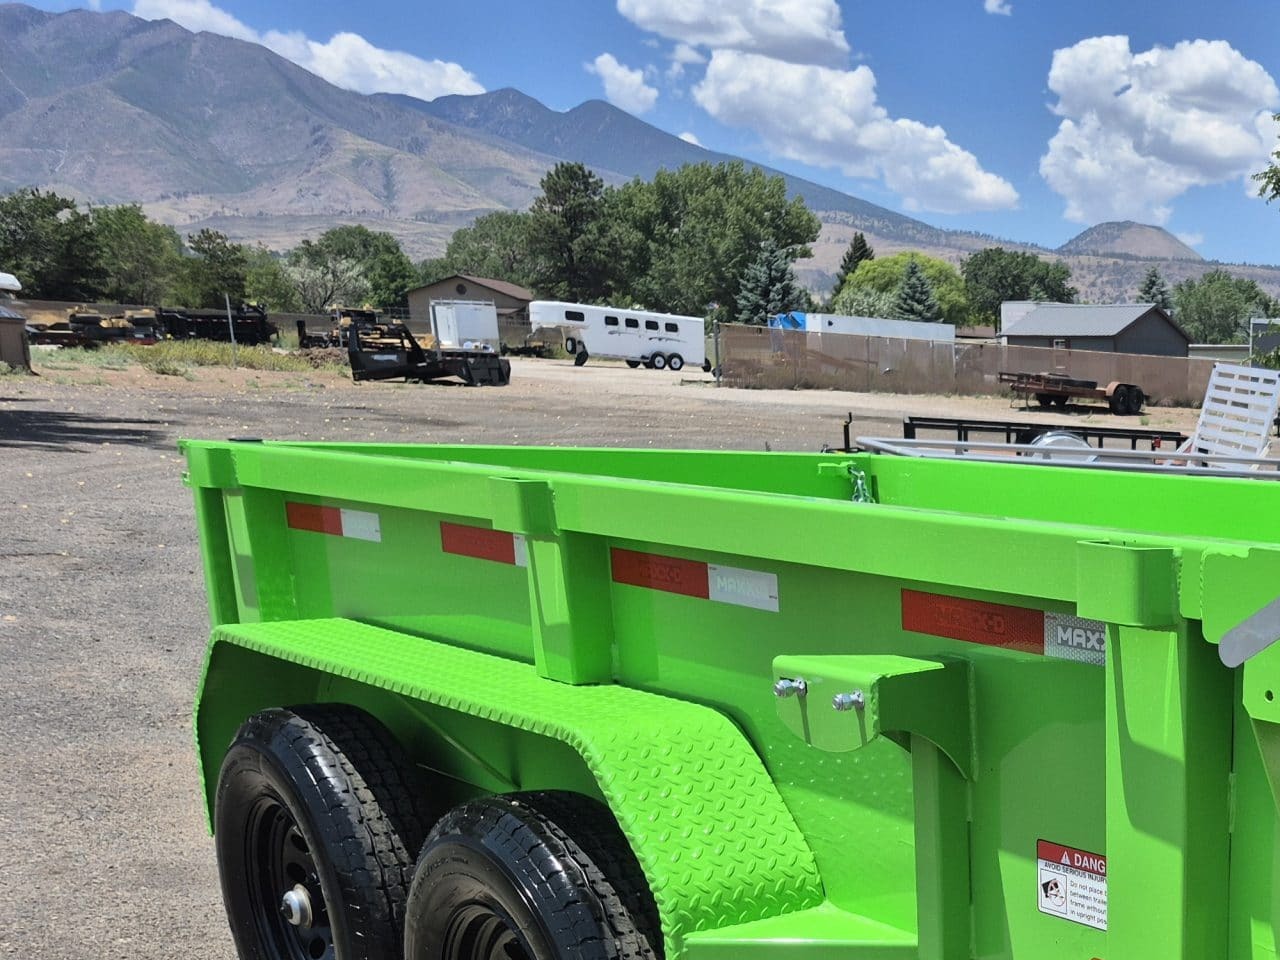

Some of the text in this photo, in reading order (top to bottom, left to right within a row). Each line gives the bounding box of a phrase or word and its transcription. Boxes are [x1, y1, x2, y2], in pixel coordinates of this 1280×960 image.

[1044, 861, 1061, 872] AVOID
[1062, 866, 1087, 879] SERIOUS
[1074, 853, 1106, 873] DANG
[1070, 880, 1078, 888] Do
[1078, 882, 1088, 890] not
[1088, 885, 1103, 895] place
[1070, 890, 1093, 902] between
[1093, 895, 1107, 906] traile
[1076, 911, 1096, 922] upright
